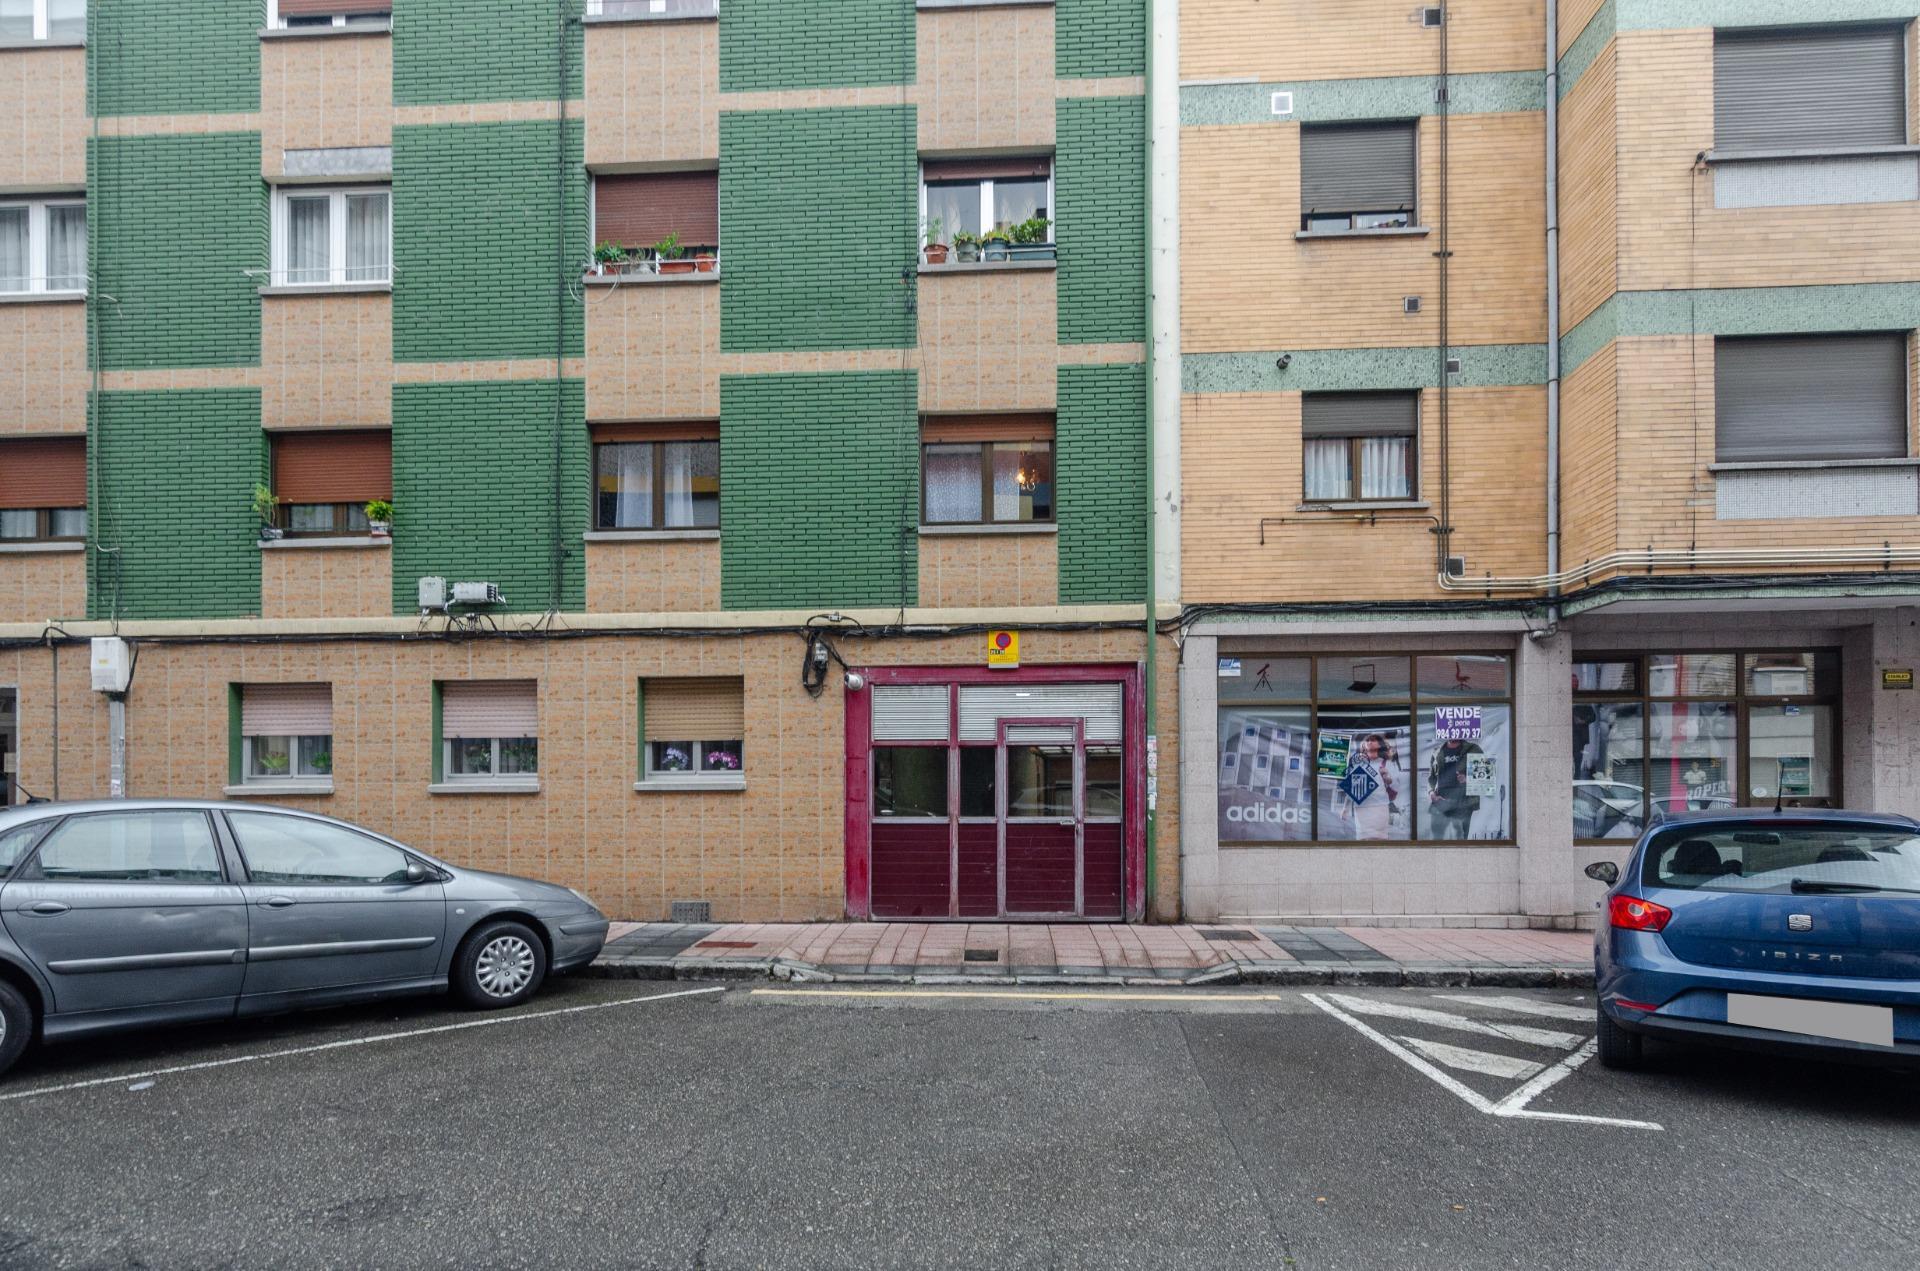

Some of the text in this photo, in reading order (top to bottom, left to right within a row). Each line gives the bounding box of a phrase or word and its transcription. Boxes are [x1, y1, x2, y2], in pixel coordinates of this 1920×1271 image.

[1437, 707, 1481, 718] VENDE
[1451, 728, 1460, 739] 39
[1461, 728, 1471, 739] 79
[1471, 727, 1481, 738] 37
[1226, 802, 1312, 823] adidas
[1761, 950, 1842, 962] IBIZA
